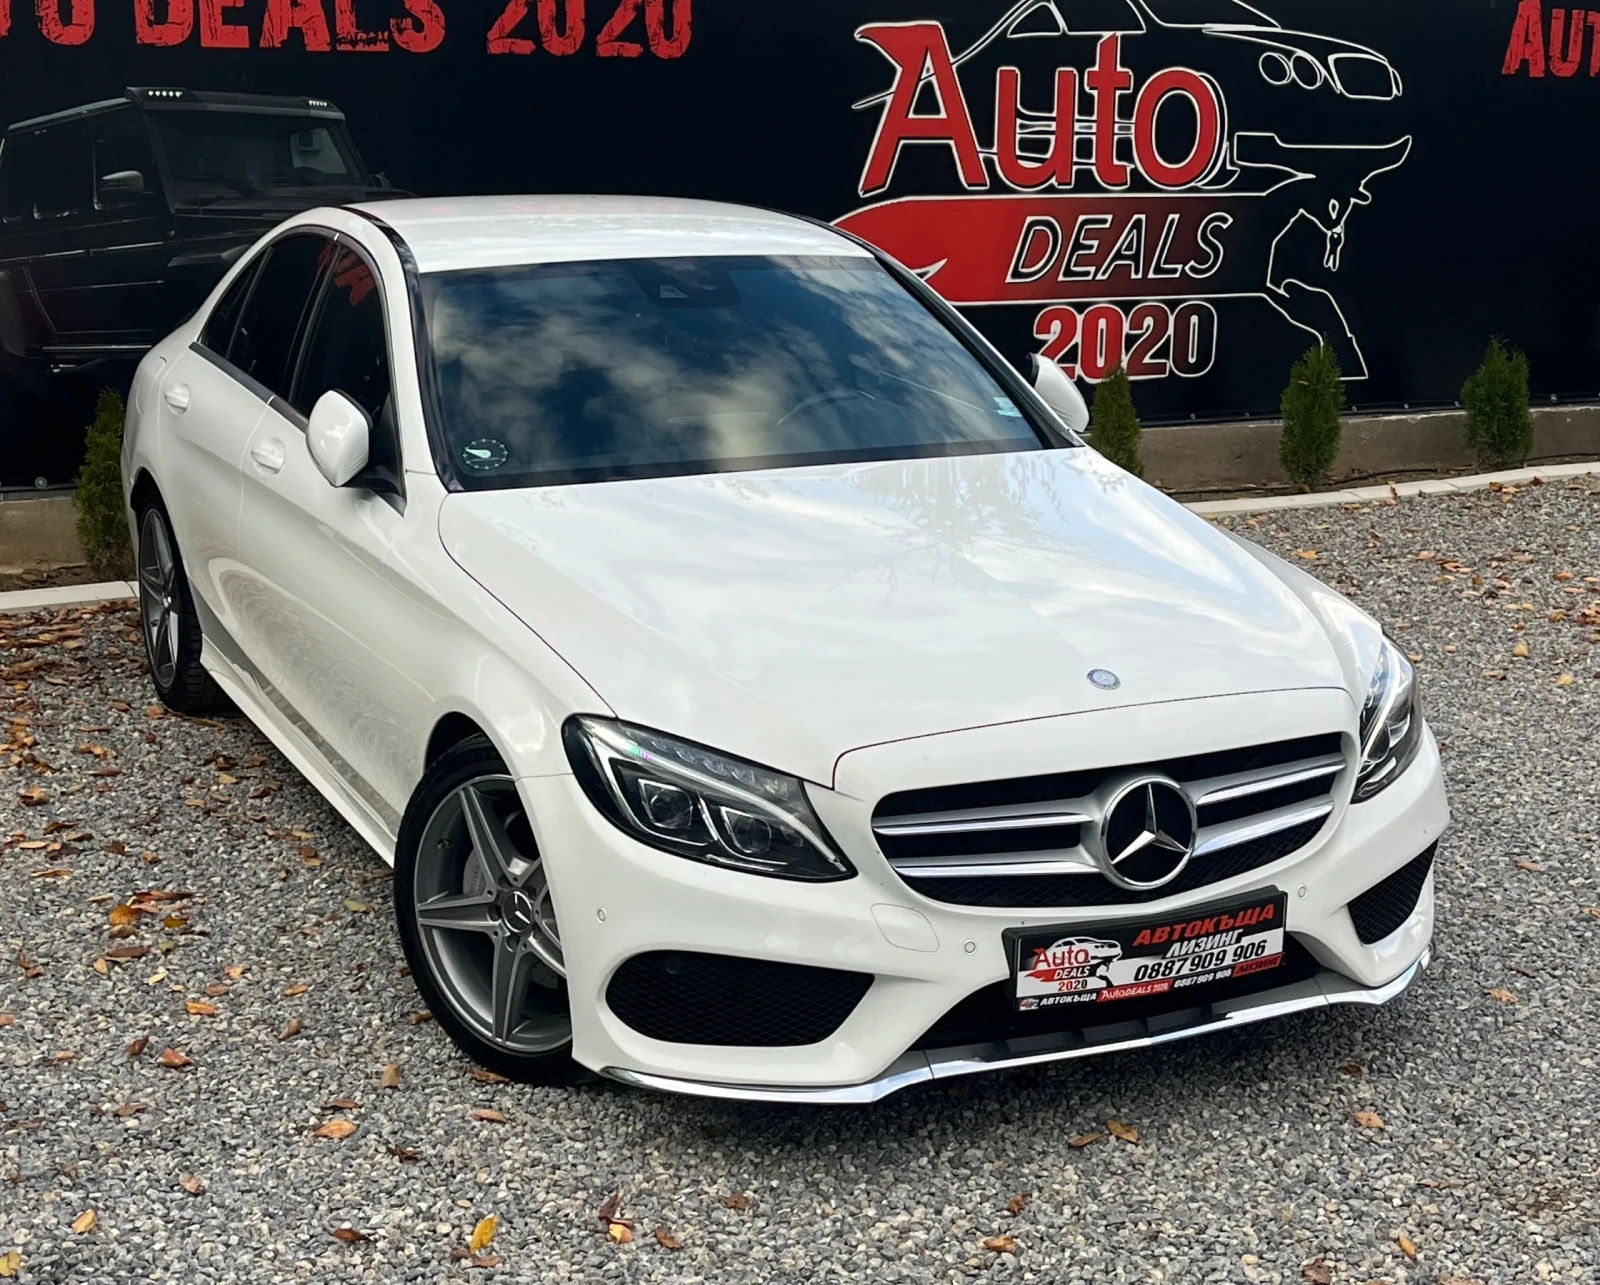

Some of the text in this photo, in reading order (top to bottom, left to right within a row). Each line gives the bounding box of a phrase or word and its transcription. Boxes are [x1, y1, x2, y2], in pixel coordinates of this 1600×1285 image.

[854, 21, 1221, 197] Auto
[1005, 211, 1234, 284] DEALS
[1033, 301, 1218, 384] 2020
[1132, 903, 1275, 947] АВТОКЪЩА
[1032, 945, 1090, 971] Auto
[1165, 928, 1244, 959] ЛИЗИНГ
[1231, 939, 1268, 963] 906
[1053, 966, 1091, 980] DEALS
[1057, 979, 1088, 992] 2020
